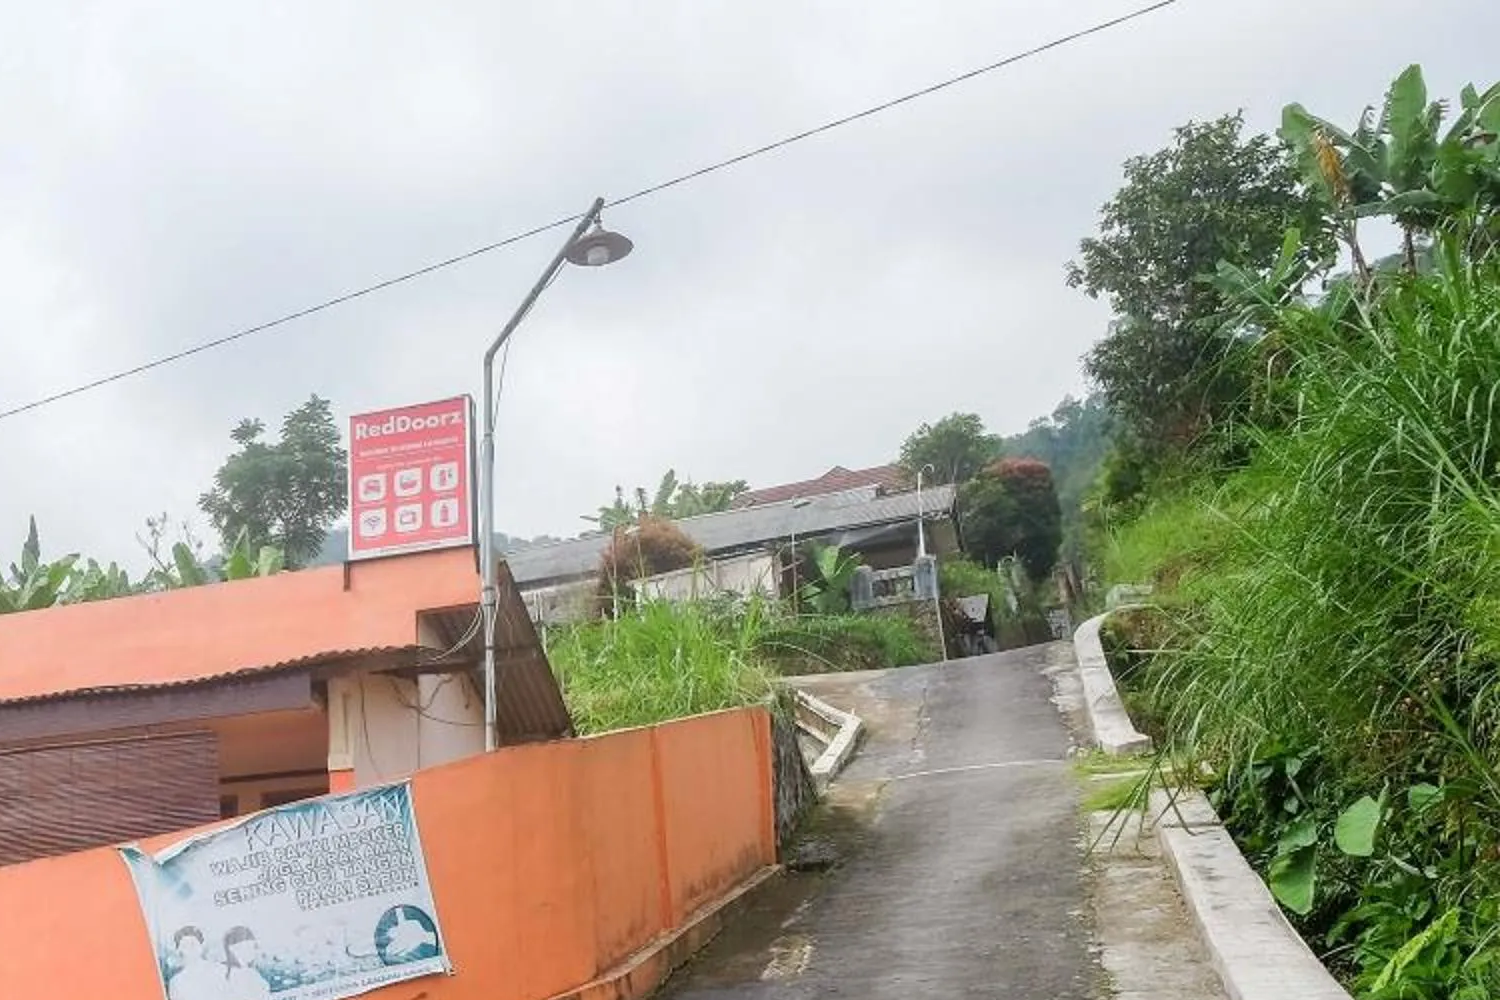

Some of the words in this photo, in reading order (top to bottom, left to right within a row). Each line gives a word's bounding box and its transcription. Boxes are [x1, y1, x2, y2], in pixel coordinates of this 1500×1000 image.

[355, 411, 462, 441] RedDoorz
[210, 851, 270, 877] WAJIB
[272, 838, 330, 865] PAKAI
[331, 823, 405, 849] MASKER
[243, 795, 404, 851] KAWASAN
[213, 876, 288, 908] SERING
[340, 850, 416, 878] TANGAN
[295, 878, 353, 906] PAKAI
